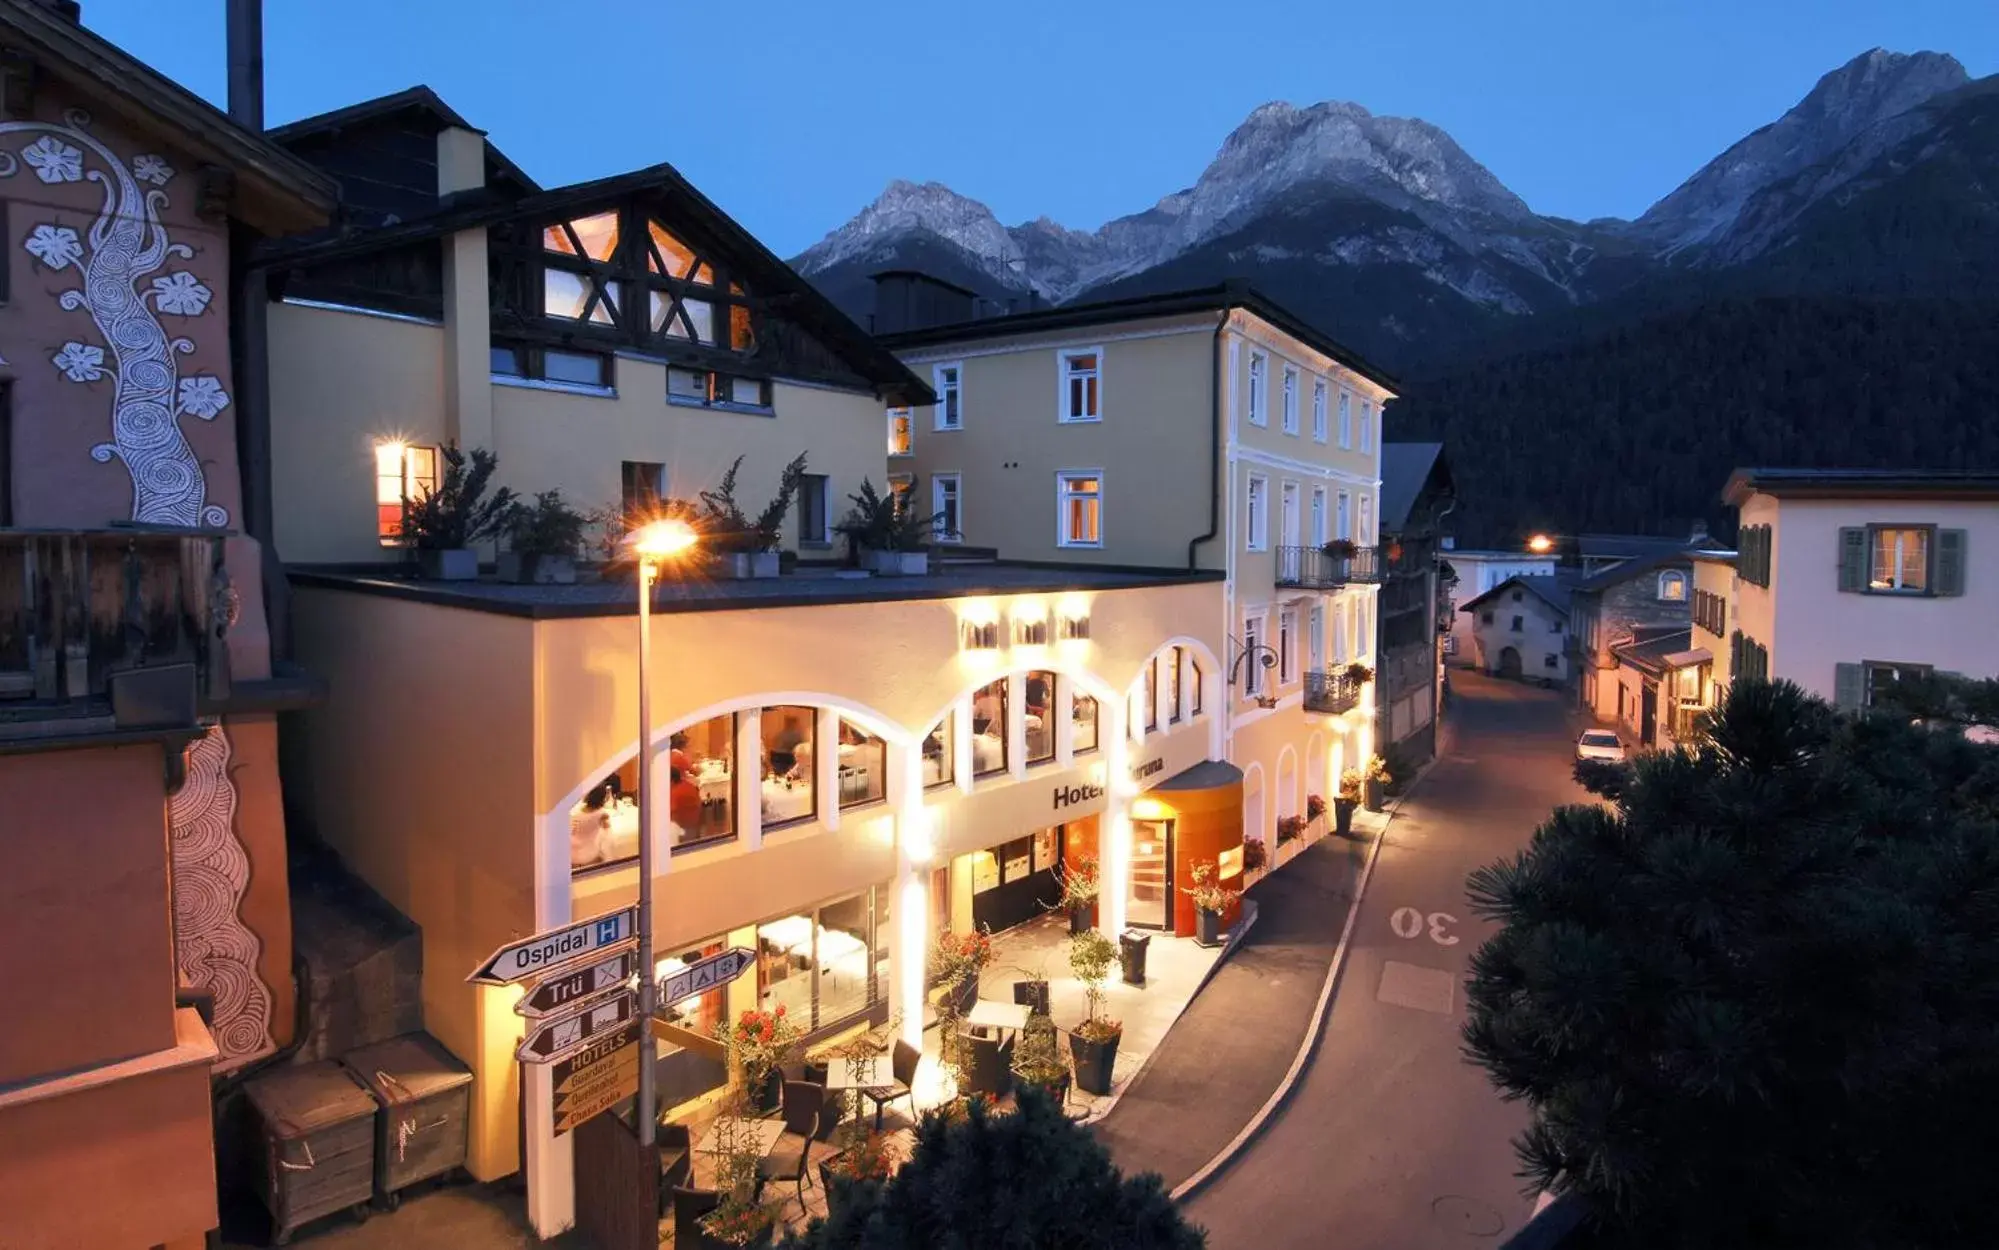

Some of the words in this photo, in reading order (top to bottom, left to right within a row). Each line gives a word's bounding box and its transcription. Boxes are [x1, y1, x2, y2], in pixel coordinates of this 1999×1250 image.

[1390, 907, 1460, 945] 30
[517, 929, 587, 968] Ospidal
[548, 976, 583, 1002] Trü
[571, 1033, 627, 1071] HOTELS
